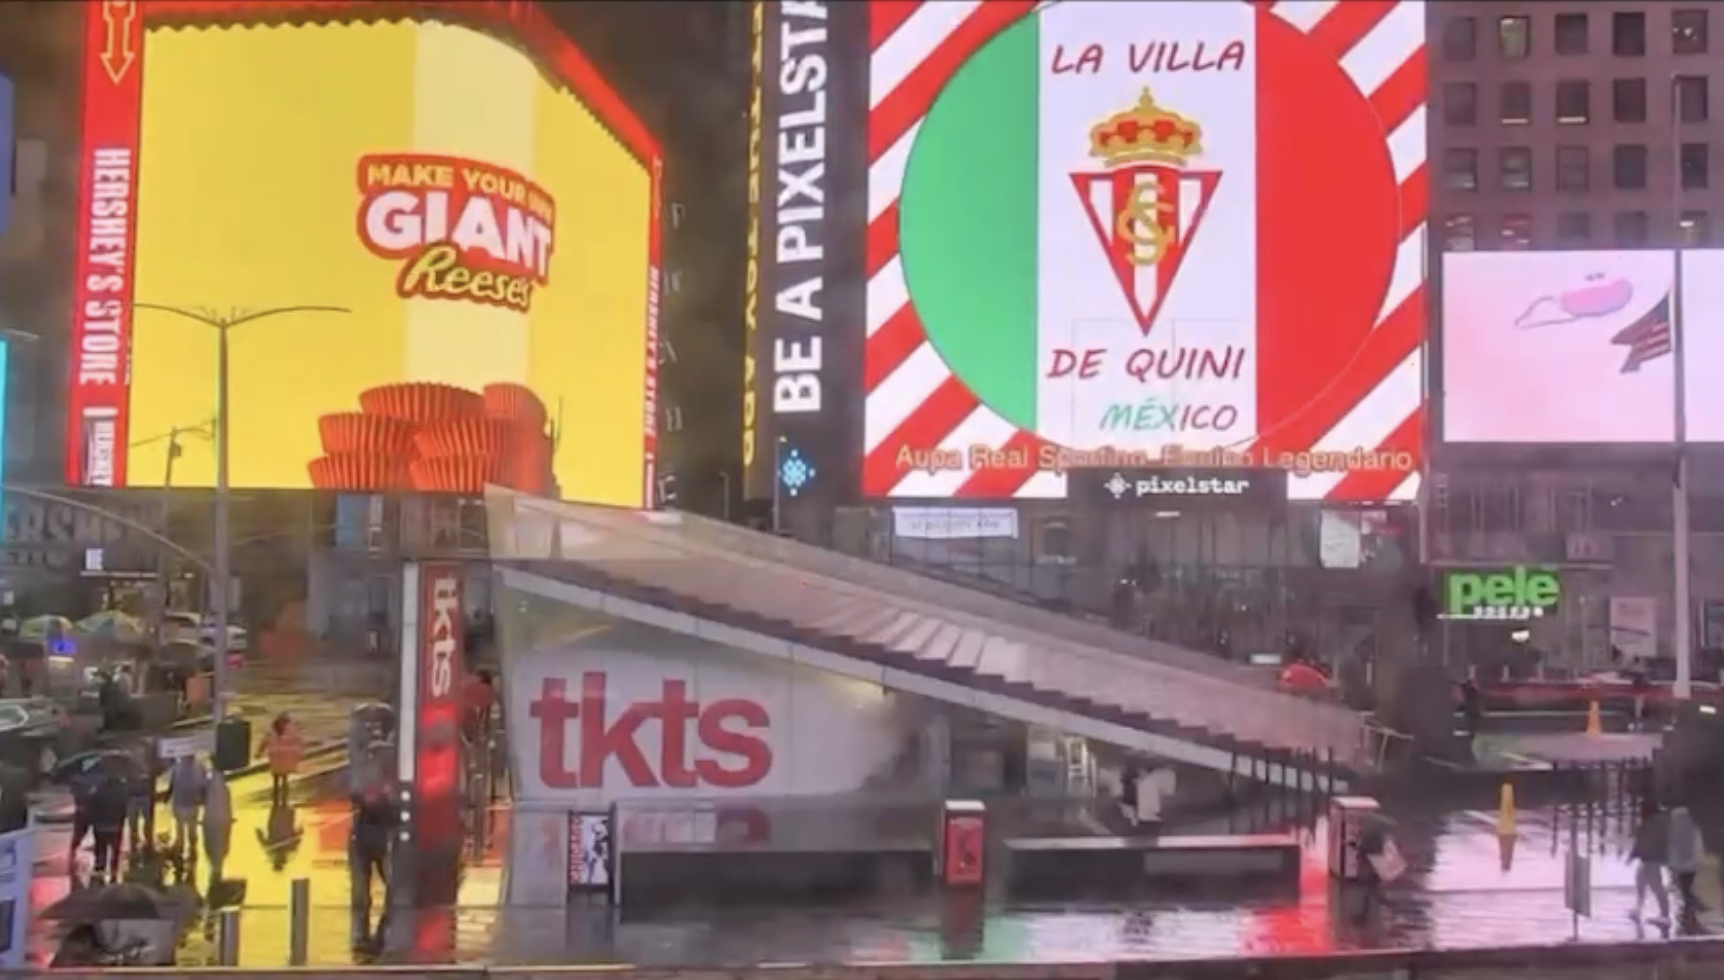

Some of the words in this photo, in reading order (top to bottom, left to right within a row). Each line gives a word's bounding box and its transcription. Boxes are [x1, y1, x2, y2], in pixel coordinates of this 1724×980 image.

[1051, 43, 1104, 74] LA
[1128, 40, 1246, 73] VILLA
[367, 163, 454, 187] MAKE
[461, 167, 527, 204] YOUR
[86, 148, 131, 292] HERSHEY'S
[366, 190, 552, 277] GIANT
[775, 277, 823, 321] A
[79, 299, 123, 385] STORE
[1046, 348, 1108, 379] DE
[1125, 345, 1245, 384] QUINI
[774, 336, 823, 412] BE
[1099, 396, 1239, 432] MÉXICO
[895, 443, 962, 477] Aupa
[968, 444, 1029, 469] Real
[1262, 445, 1413, 478] Legendario
[1136, 475, 1250, 498] pixelstar
[1449, 565, 1560, 615] pele
[432, 577, 458, 697] tkts
[529, 671, 773, 789] tkts
